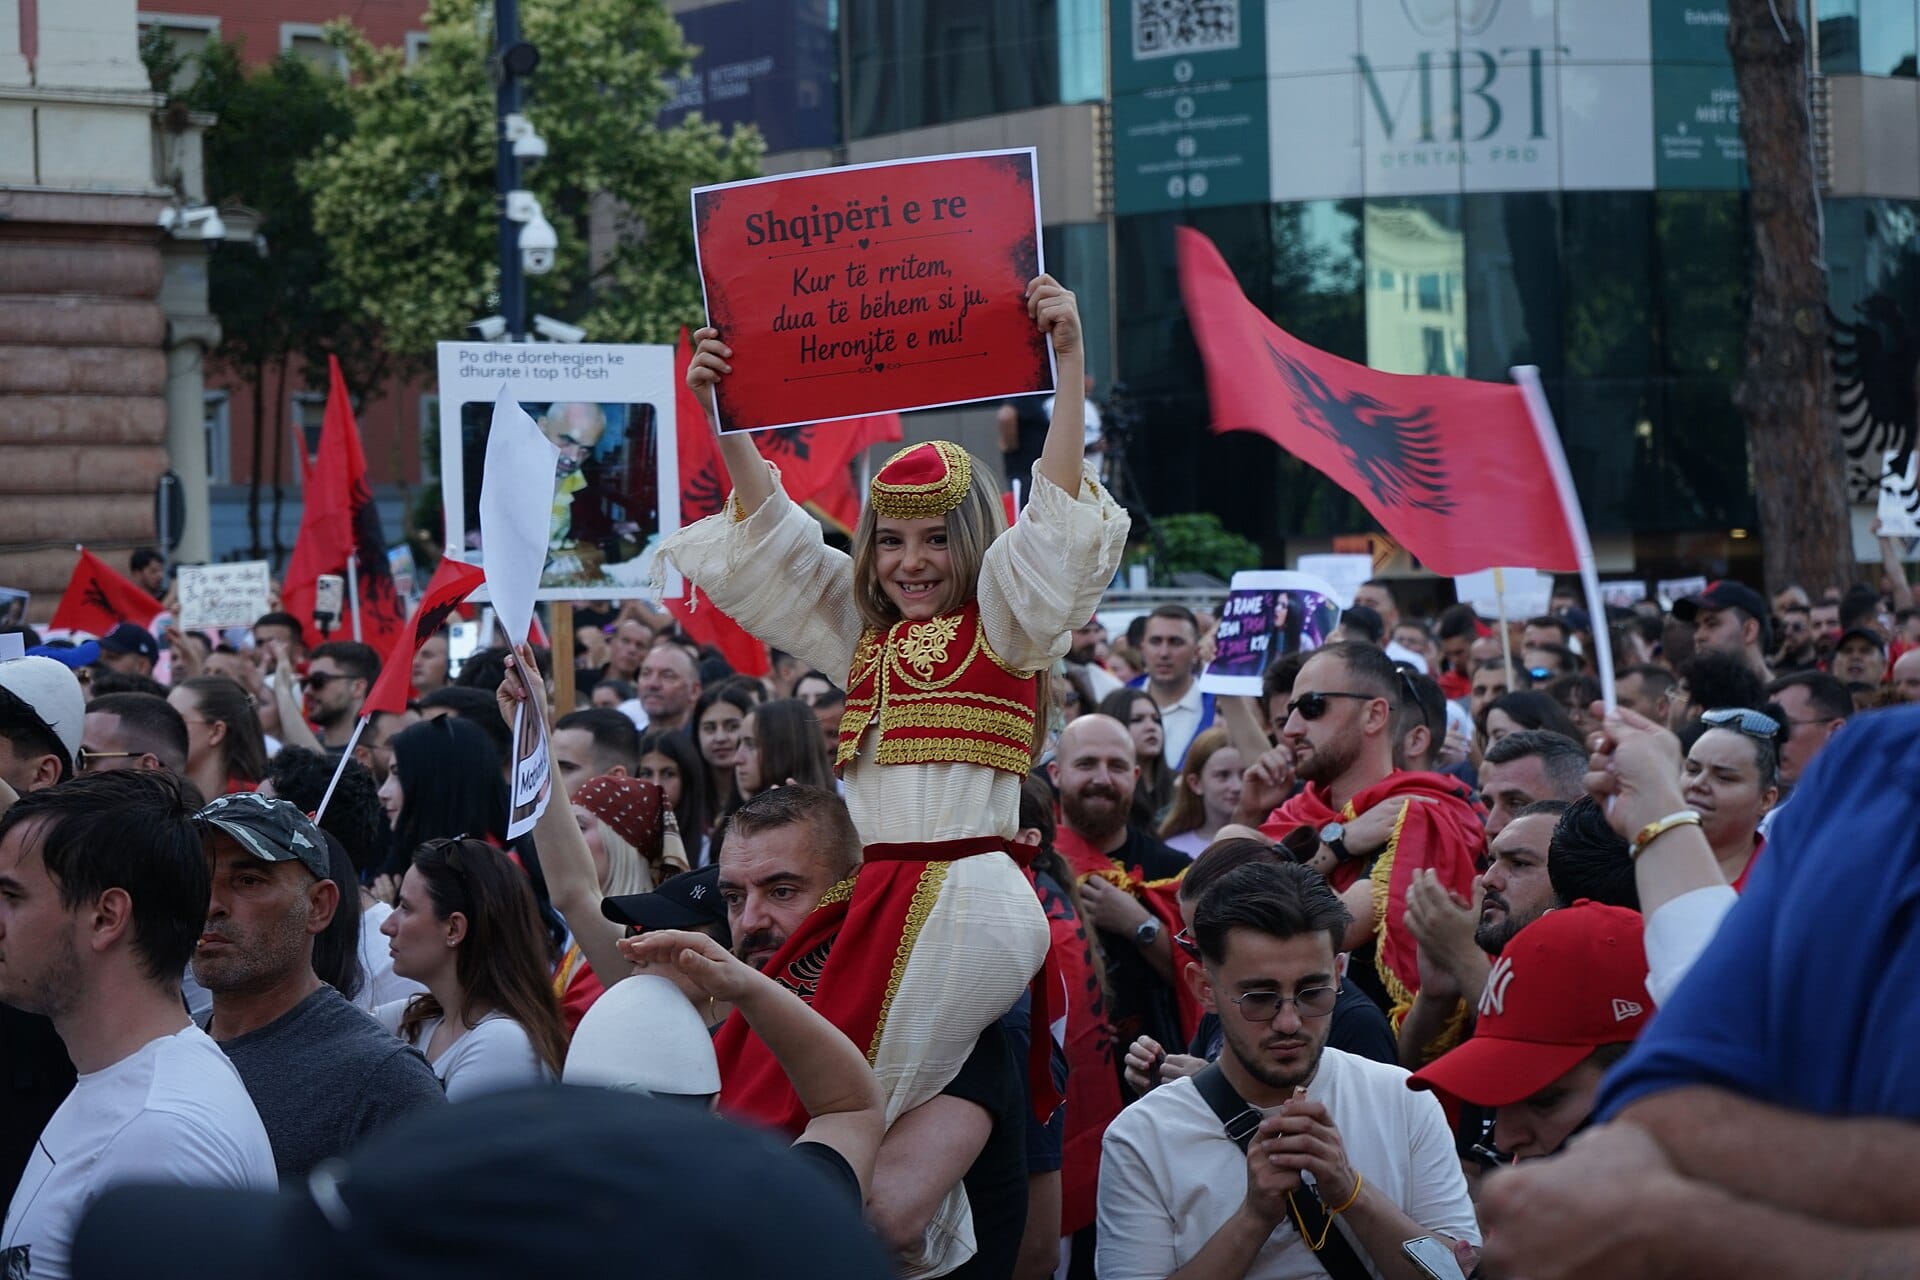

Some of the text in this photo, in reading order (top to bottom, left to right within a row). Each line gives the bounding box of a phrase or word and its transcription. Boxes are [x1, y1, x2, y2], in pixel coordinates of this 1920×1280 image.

[1350, 46, 1571, 144] MBT
[1380, 146, 1538, 168] DENTAL PRO
[745, 195, 967, 248] Shqipëri e re
[793, 253, 952, 296] Kur të rritem,
[772, 284, 989, 332] dua të bëhem si ju.
[459, 351, 480, 364] Po
[483, 350, 513, 364] dhe
[608, 352, 624, 365] ke
[800, 317, 964, 365] Heronjtë e mi!
[459, 364, 609, 380] dhurate i top 10-tsh
